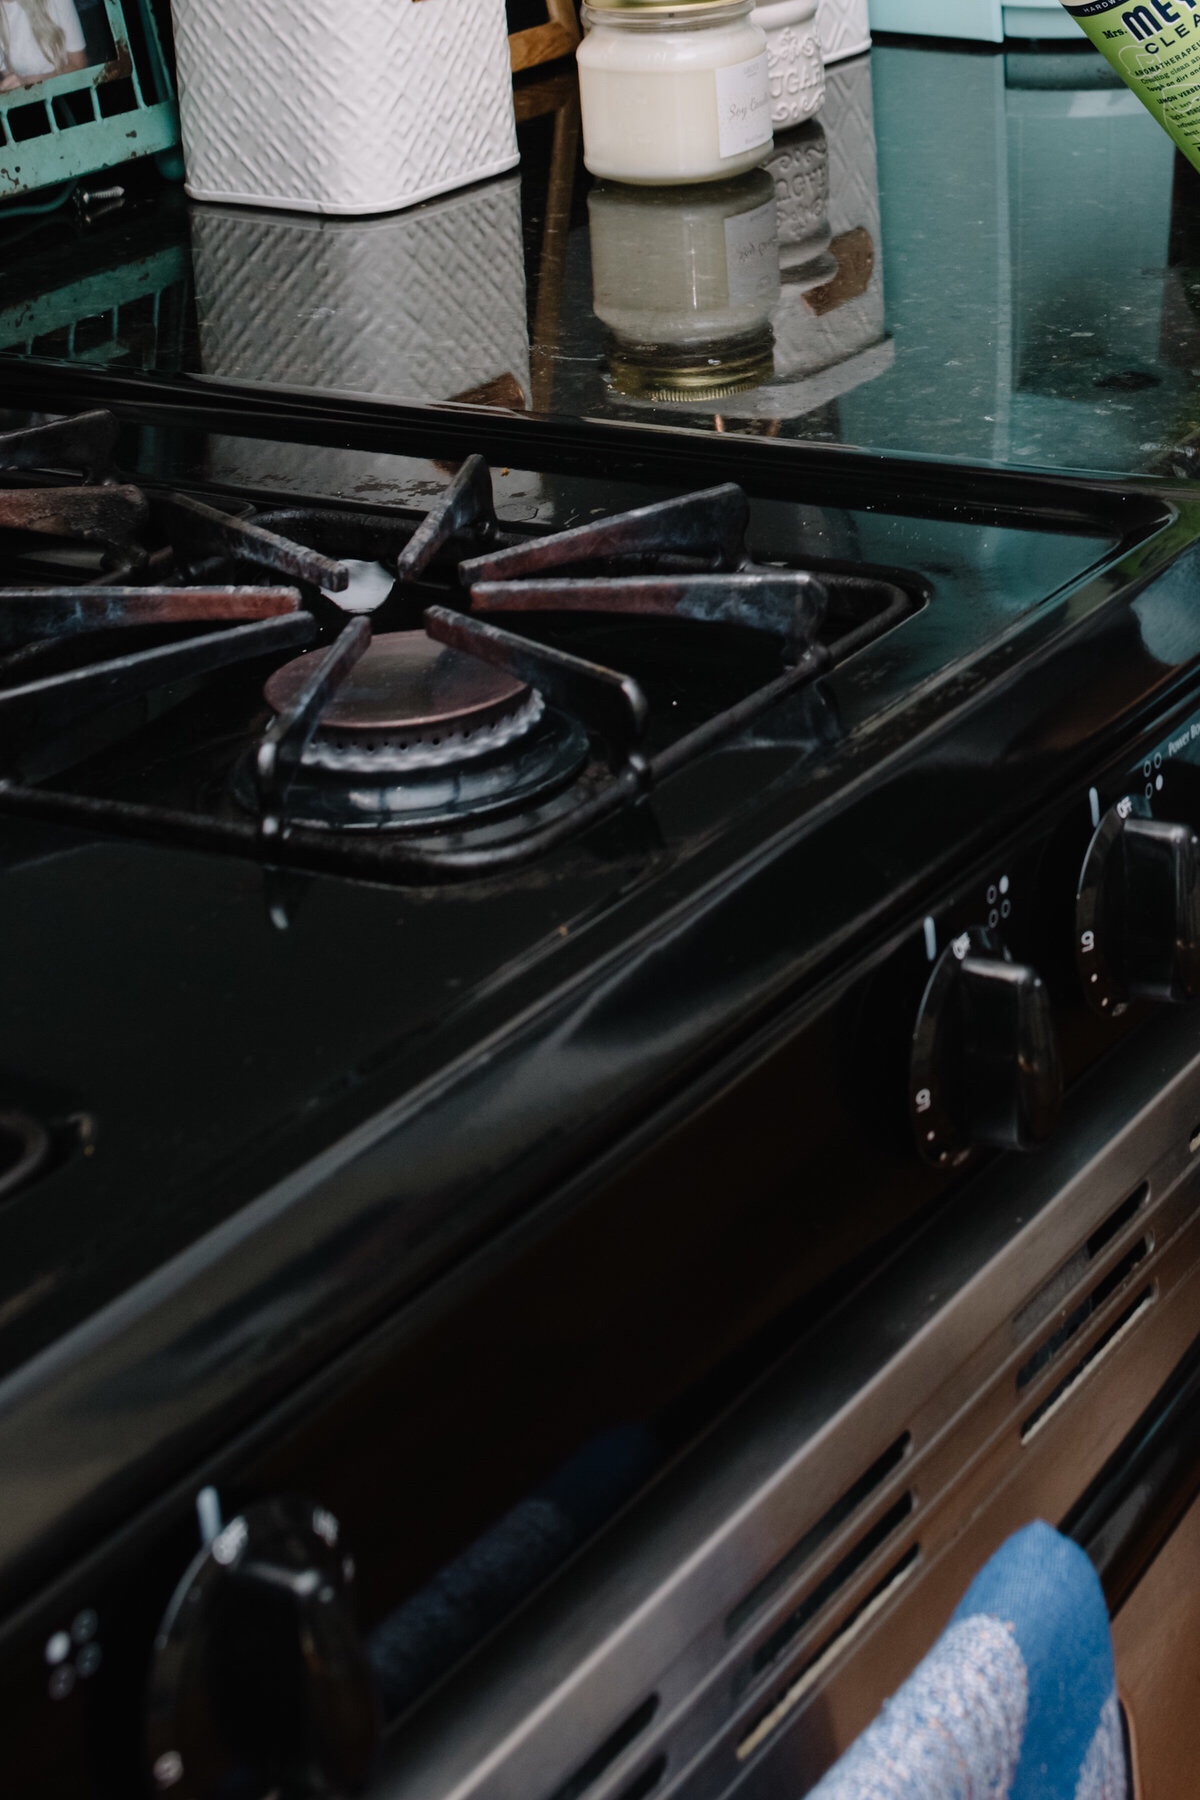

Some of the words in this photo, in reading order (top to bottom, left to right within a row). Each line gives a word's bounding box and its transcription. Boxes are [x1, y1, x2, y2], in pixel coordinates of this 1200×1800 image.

[1102, 28, 1128, 40] Mrs.
[1171, 62, 1191, 75] clean
[1176, 74, 1189, 83] dirt
[1168, 731, 1191, 757] Power
